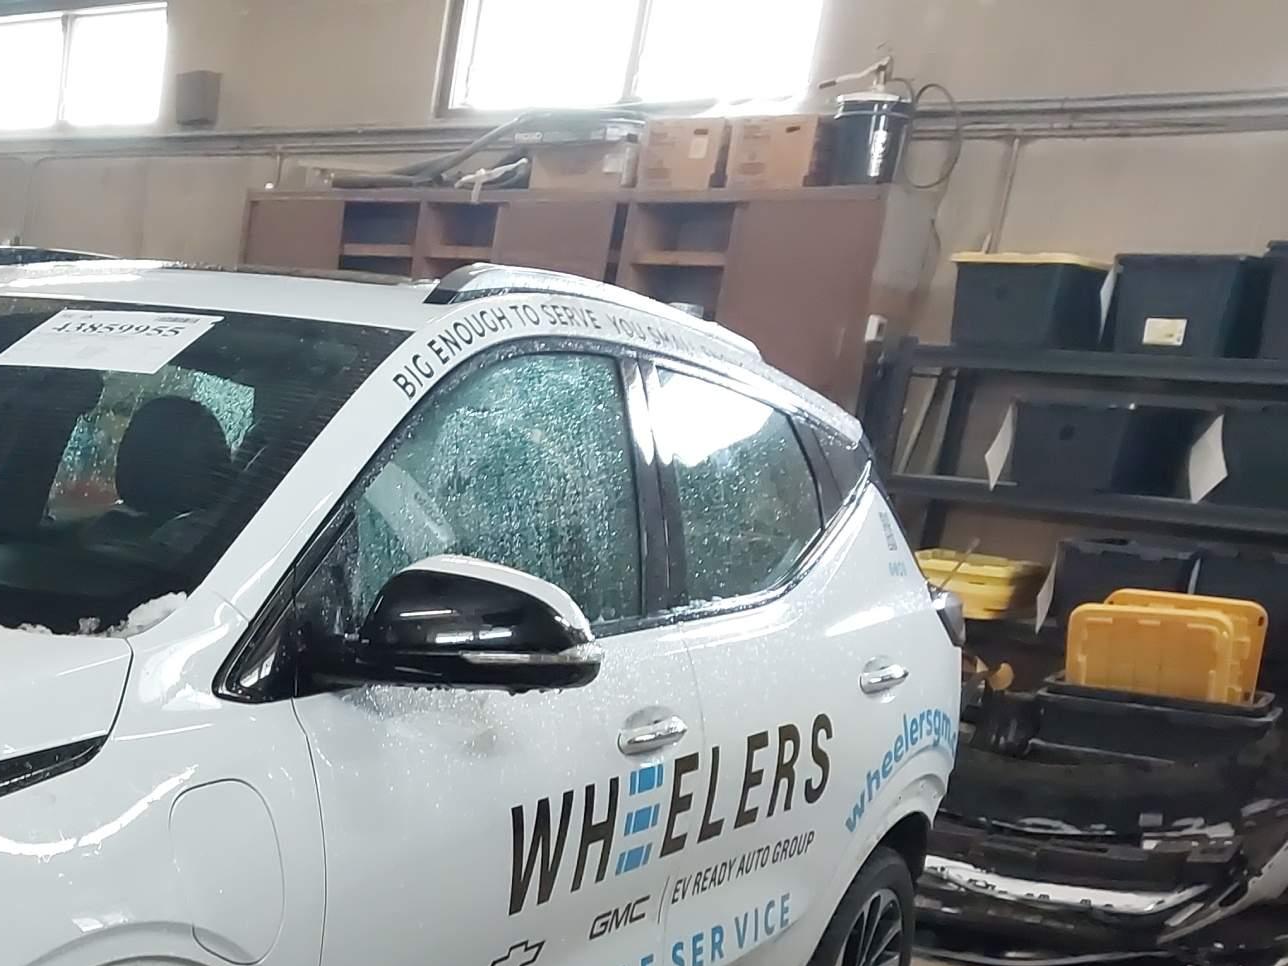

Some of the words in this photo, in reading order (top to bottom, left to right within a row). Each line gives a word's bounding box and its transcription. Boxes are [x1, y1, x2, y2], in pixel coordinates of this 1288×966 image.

[51, 321, 187, 338] 43859955
[392, 354, 434, 401] BIG
[427, 305, 511, 366] ENOUGH
[509, 303, 541, 328] TO
[541, 303, 602, 330] SERVE
[606, 313, 647, 342] YOU
[508, 713, 833, 917] WHEELERS
[588, 894, 651, 940] GMC
[670, 874, 694, 905] EV
[691, 860, 737, 897] READY
[735, 846, 771, 879] AUTO
[771, 830, 816, 864] GROUP
